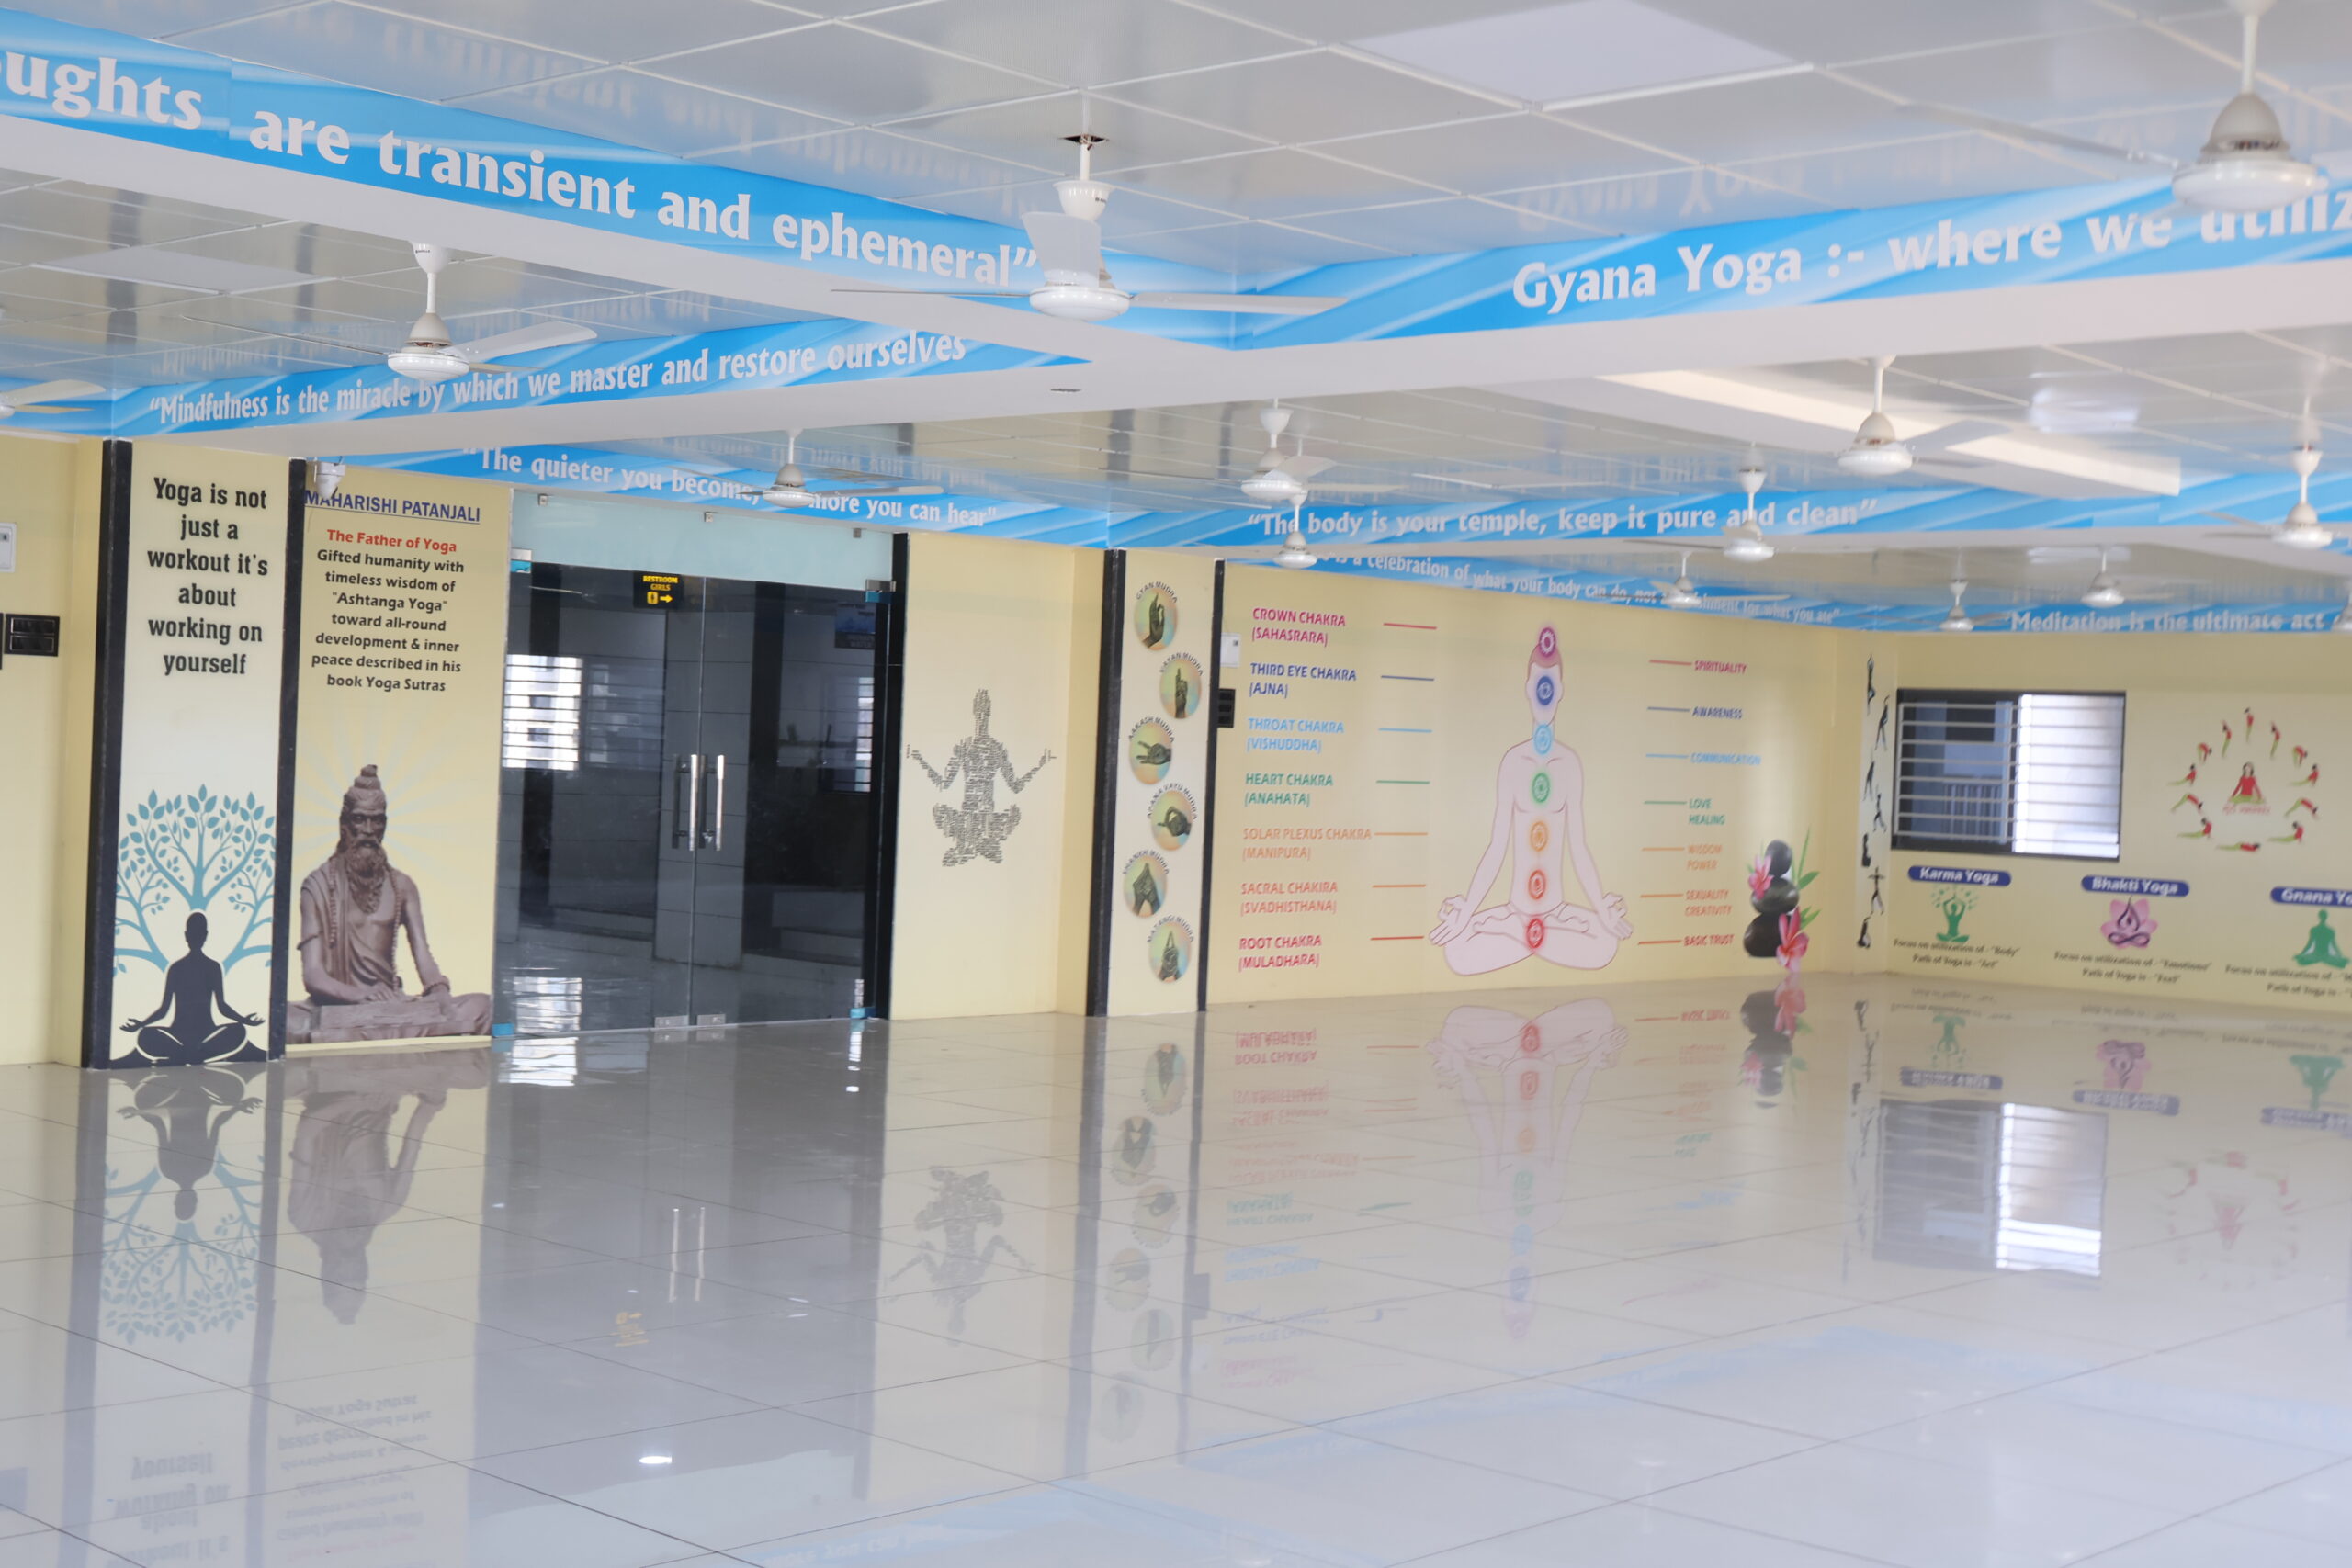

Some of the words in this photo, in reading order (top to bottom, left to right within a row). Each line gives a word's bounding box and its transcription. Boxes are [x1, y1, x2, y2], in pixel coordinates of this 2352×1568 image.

[0, 51, 202, 130] ughts
[249, 110, 351, 164] are
[378, 130, 636, 219] transient
[657, 191, 752, 241] and
[772, 211, 1037, 288] ephemeral”
[1512, 261, 1656, 315] Gyana
[1677, 243, 1802, 295] Yoga
[1887, 219, 2063, 271] where
[2085, 213, 2173, 254] we
[149, 391, 268, 424] “Mindfulness
[276, 386, 290, 415] is
[298, 384, 330, 413] the
[336, 378, 411, 412] miracle
[418, 379, 446, 412] by
[452, 373, 519, 404] which
[527, 373, 561, 396] we
[570, 361, 654, 394] master
[661, 348, 709, 386] and
[718, 346, 816, 380] restore
[826, 330, 967, 371] ourselves
[153, 476, 202, 506] Yoga
[209, 483, 228, 505] is
[235, 489, 266, 509] not
[530, 454, 614, 484] quieter
[620, 467, 662, 491] you
[671, 469, 760, 505] become,
[865, 499, 903, 519] you
[909, 502, 941, 523] can
[402, 500, 481, 523] PATANJALI
[1307, 511, 1363, 536] body
[1371, 510, 1388, 533] is
[1396, 514, 1448, 537] your
[1458, 508, 1547, 536] temple,
[1558, 507, 1618, 535] keep
[1627, 504, 1647, 530] it
[1657, 506, 1717, 534] pure
[1726, 502, 1776, 526] and
[179, 513, 220, 541] just
[227, 523, 239, 540] a
[327, 528, 354, 543] The
[356, 532, 402, 547] Father
[405, 537, 421, 549] of
[424, 538, 458, 555] Yoga
[146, 548, 231, 573] workout
[237, 552, 268, 576] it's
[317, 548, 361, 565] Gifted
[365, 553, 431, 573] humanity
[434, 559, 465, 573] with
[325, 570, 382, 587] timeless
[385, 576, 438, 591] wisdom
[441, 580, 457, 592] of
[1366, 556, 1450, 578] celebration
[1453, 563, 1471, 581] of
[1473, 570, 1507, 590] what
[1510, 578, 1544, 593] your
[1548, 575, 1581, 600] body
[1585, 584, 1606, 598] can
[1792, 607, 1814, 624] you
[177, 582, 237, 607] about
[332, 592, 405, 611] "Ashtanga
[408, 598, 448, 614] Yoga"
[331, 613, 382, 628] toward
[385, 616, 447, 632] all-round
[1252, 607, 1296, 623] CROWN
[1298, 611, 1346, 626] CHAKRA
[2129, 610, 2145, 632] is
[2154, 612, 2188, 632] the
[2192, 610, 2283, 632] ultimate
[2290, 613, 2324, 630] act
[147, 616, 232, 646] working
[238, 625, 264, 642] on
[1251, 626, 1329, 648] (SAHASRARA)
[315, 632, 408, 649] development
[411, 637, 421, 650] &
[424, 638, 460, 653] inner
[163, 653, 247, 676] yourself
[311, 653, 353, 668] peace
[356, 655, 423, 671] described
[425, 659, 439, 671] in
[442, 660, 462, 672] his
[1250, 662, 1284, 677] THIRD
[1287, 664, 1308, 678] EYE
[1310, 666, 1357, 682] CHAKRA
[1694, 660, 1747, 674] SPIRITUALITY
[326, 673, 363, 687] book
[366, 675, 401, 693] Yoga
[403, 678, 447, 692] Sutras
[1249, 682, 1289, 699] (AJNA)
[1692, 705, 1744, 720] AWARENESS
[1248, 717, 1295, 731] THROAT
[1297, 719, 1345, 734] CHAKRA
[1246, 737, 1322, 754] (VISHUDDHA)
[1245, 773, 1284, 785] HEART
[1286, 773, 1333, 786] CHAKRA
[1244, 792, 1311, 808] (ANAHATA)
[1689, 798, 1712, 809] LOVE
[1689, 814, 1726, 826] HEALING
[1242, 828, 1281, 840] SOLAR
[1283, 828, 1323, 840] PLEXUS
[1325, 828, 1372, 840] CHAKRA
[1241, 846, 1312, 862] (MANIPURA)
[1919, 866, 1962, 882] Karma
[1964, 869, 2000, 886] Yoga
[1240, 882, 1285, 895] SACRAL
[2091, 876, 2140, 892] Bhakti
[2142, 880, 2179, 897] Yoga
[2280, 887, 2334, 905] Gnana
[1238, 937, 1273, 950] ROOT
[1274, 934, 1323, 949] CHAKRA
[1238, 953, 1321, 972] (MULADHARA)
